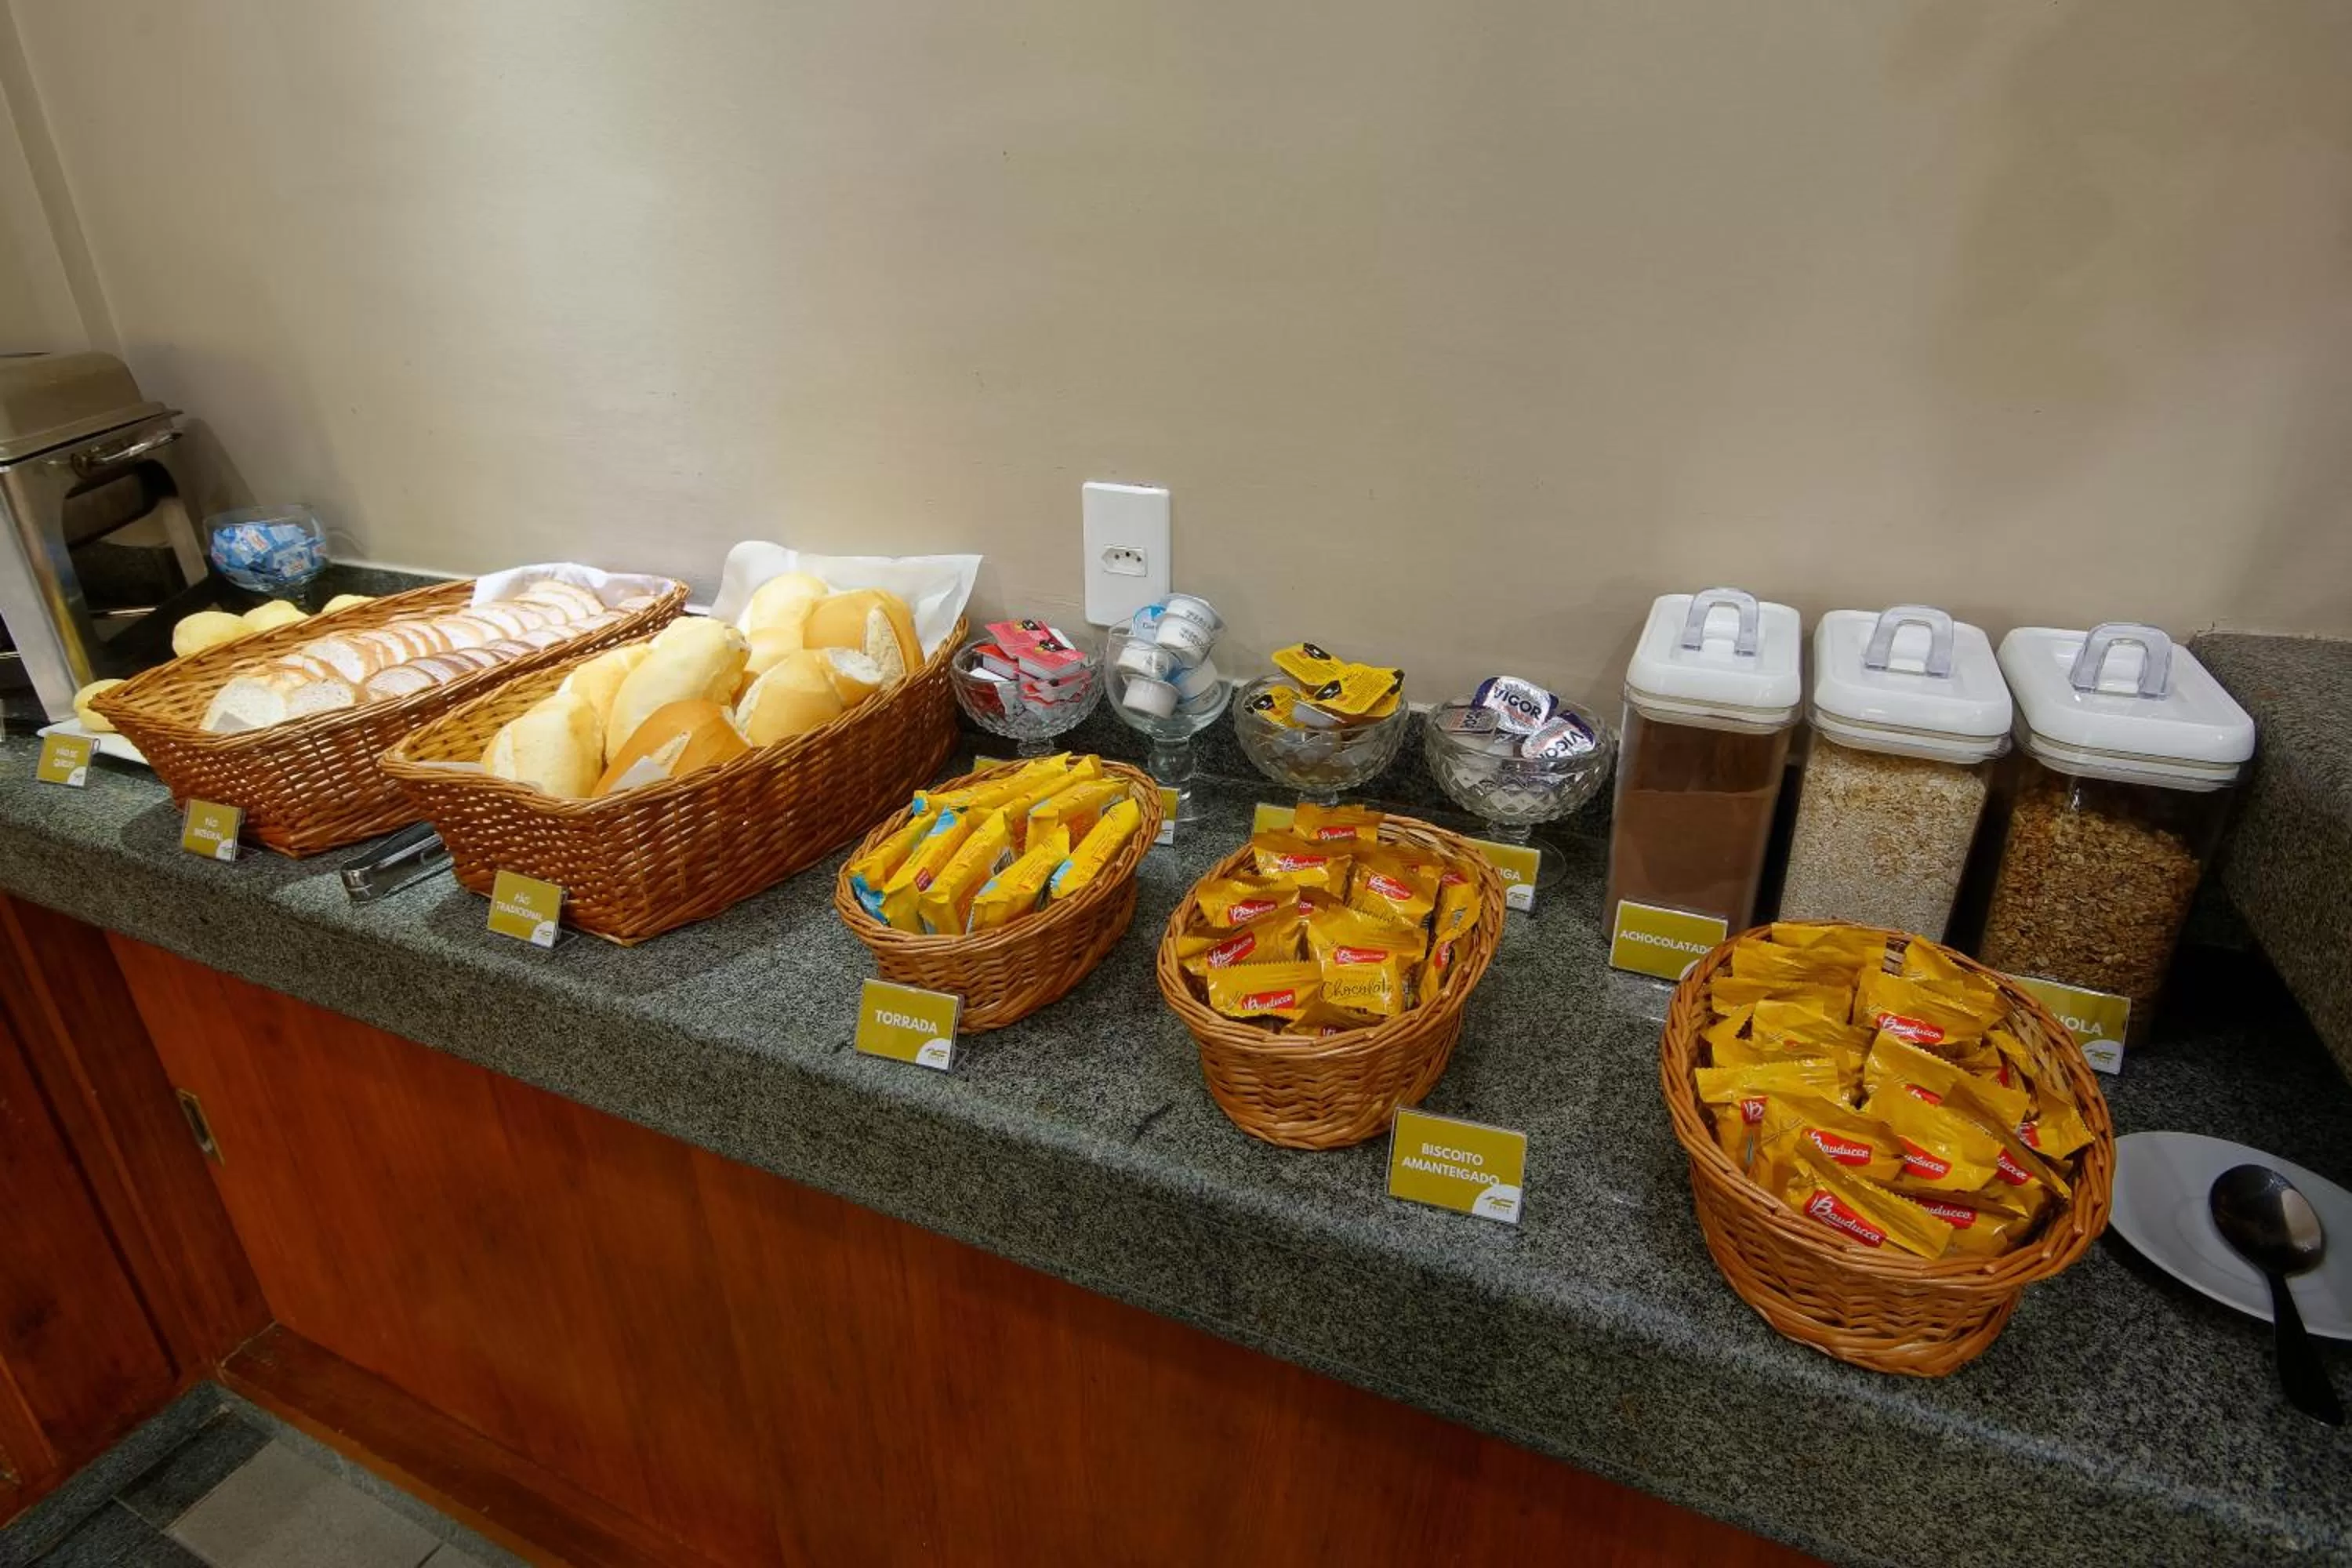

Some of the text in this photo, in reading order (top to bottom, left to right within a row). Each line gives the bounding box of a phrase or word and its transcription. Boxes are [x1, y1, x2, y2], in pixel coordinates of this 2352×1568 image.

[1494, 687, 1542, 720] VIGOR
[875, 1009, 938, 1035] TORRADA
[1878, 1014, 1940, 1039] Bauducco
[1421, 1142, 1484, 1166] BISCOITO
[1402, 1156, 1500, 1185] AMANTEIGADO
[1809, 1195, 1880, 1245] Bauducco
